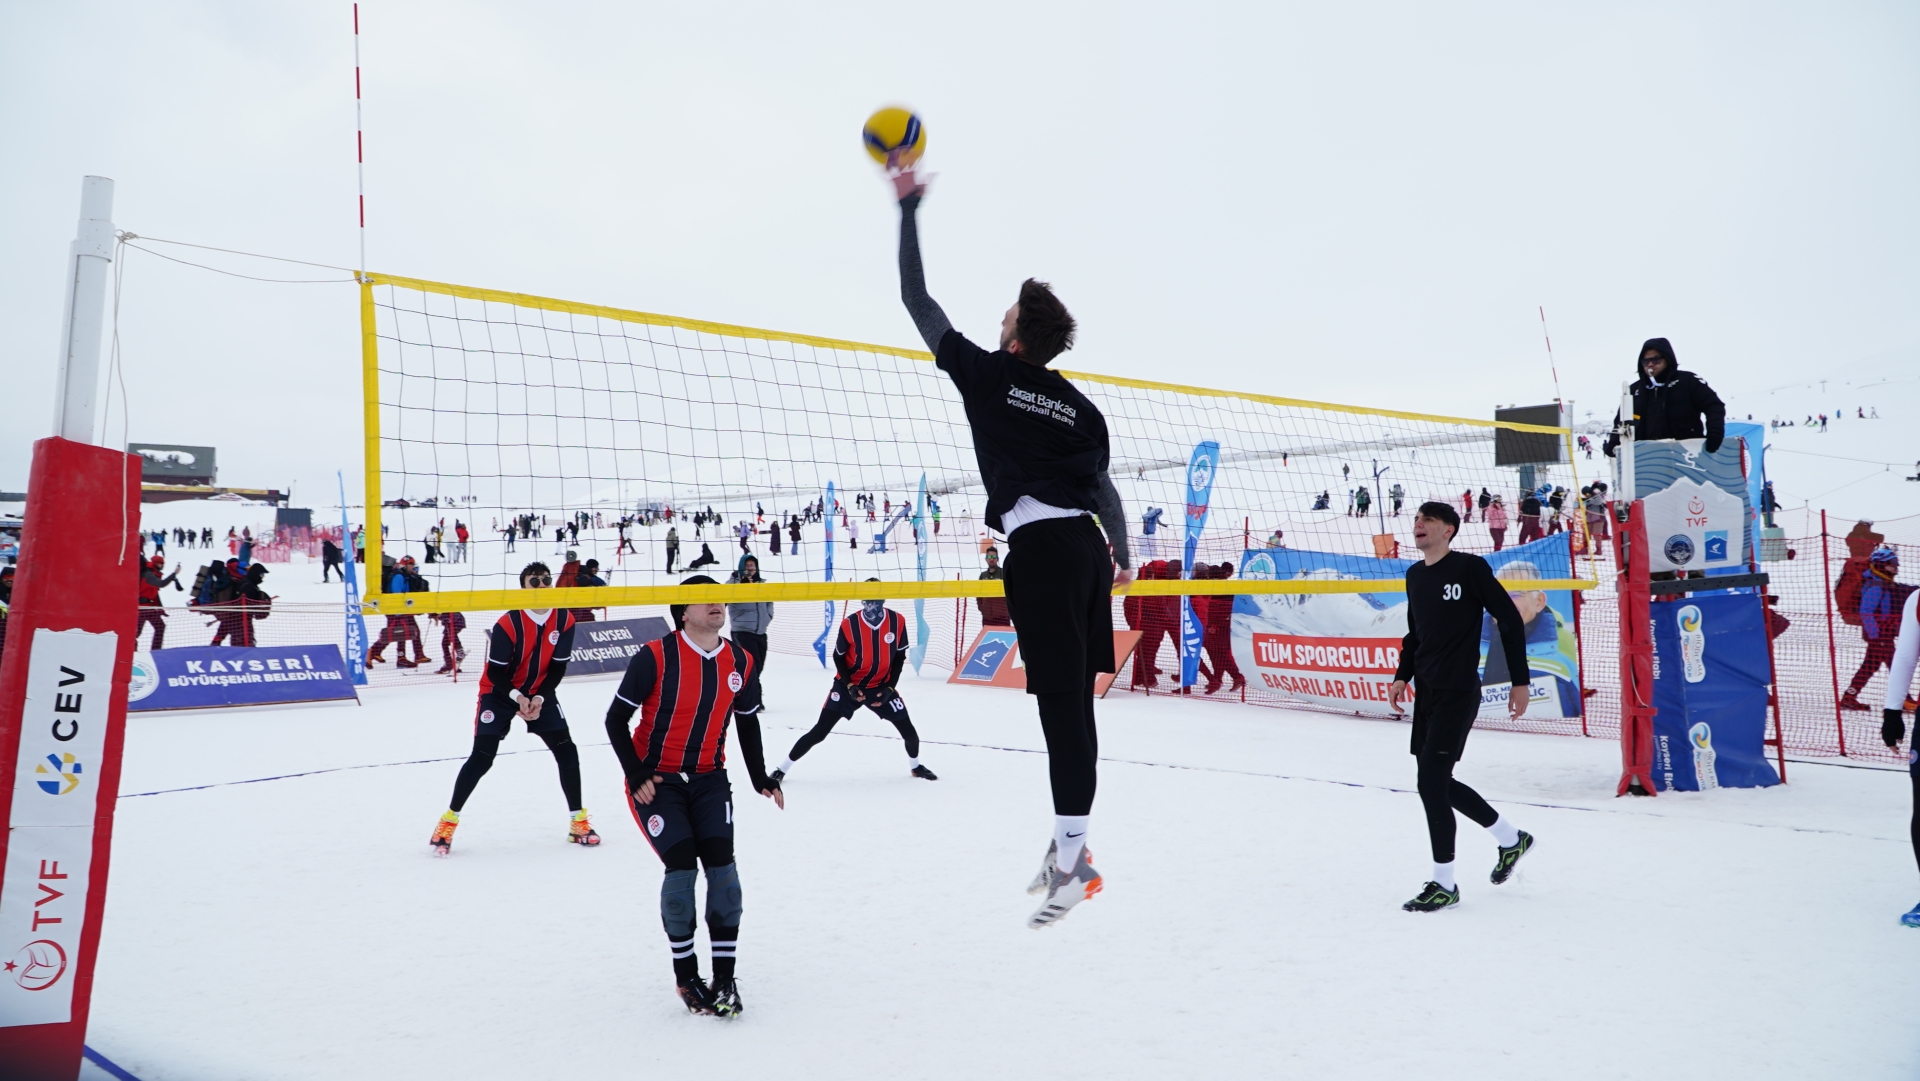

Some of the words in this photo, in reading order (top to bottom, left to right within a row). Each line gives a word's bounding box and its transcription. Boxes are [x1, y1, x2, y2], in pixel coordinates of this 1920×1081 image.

[1007, 397, 1050, 416] voleyball
[1051, 411, 1075, 427] team
[1685, 517, 1708, 528] TVF
[1442, 583, 1462, 601] 30
[589, 626, 633, 643] KAYSERİ
[570, 643, 626, 663] YÜKŞEHİR
[1258, 638, 1293, 665] TÜM
[1295, 644, 1401, 669] SPORCULAR
[185, 654, 314, 674] KAYSERİ
[167, 673, 261, 688] BÜYÜKŞEHİR
[264, 669, 343, 683] BELEDİYESİ
[1261, 672, 1348, 699] BAŞARILAR
[51, 665, 86, 742] CEV
[889, 698, 904, 713] 18
[1659, 735, 1673, 771] Kayseri
[1706, 750, 1716, 789] BIODERM
[1664, 772, 1675, 792] Etab
[31, 859, 69, 933] TVF
